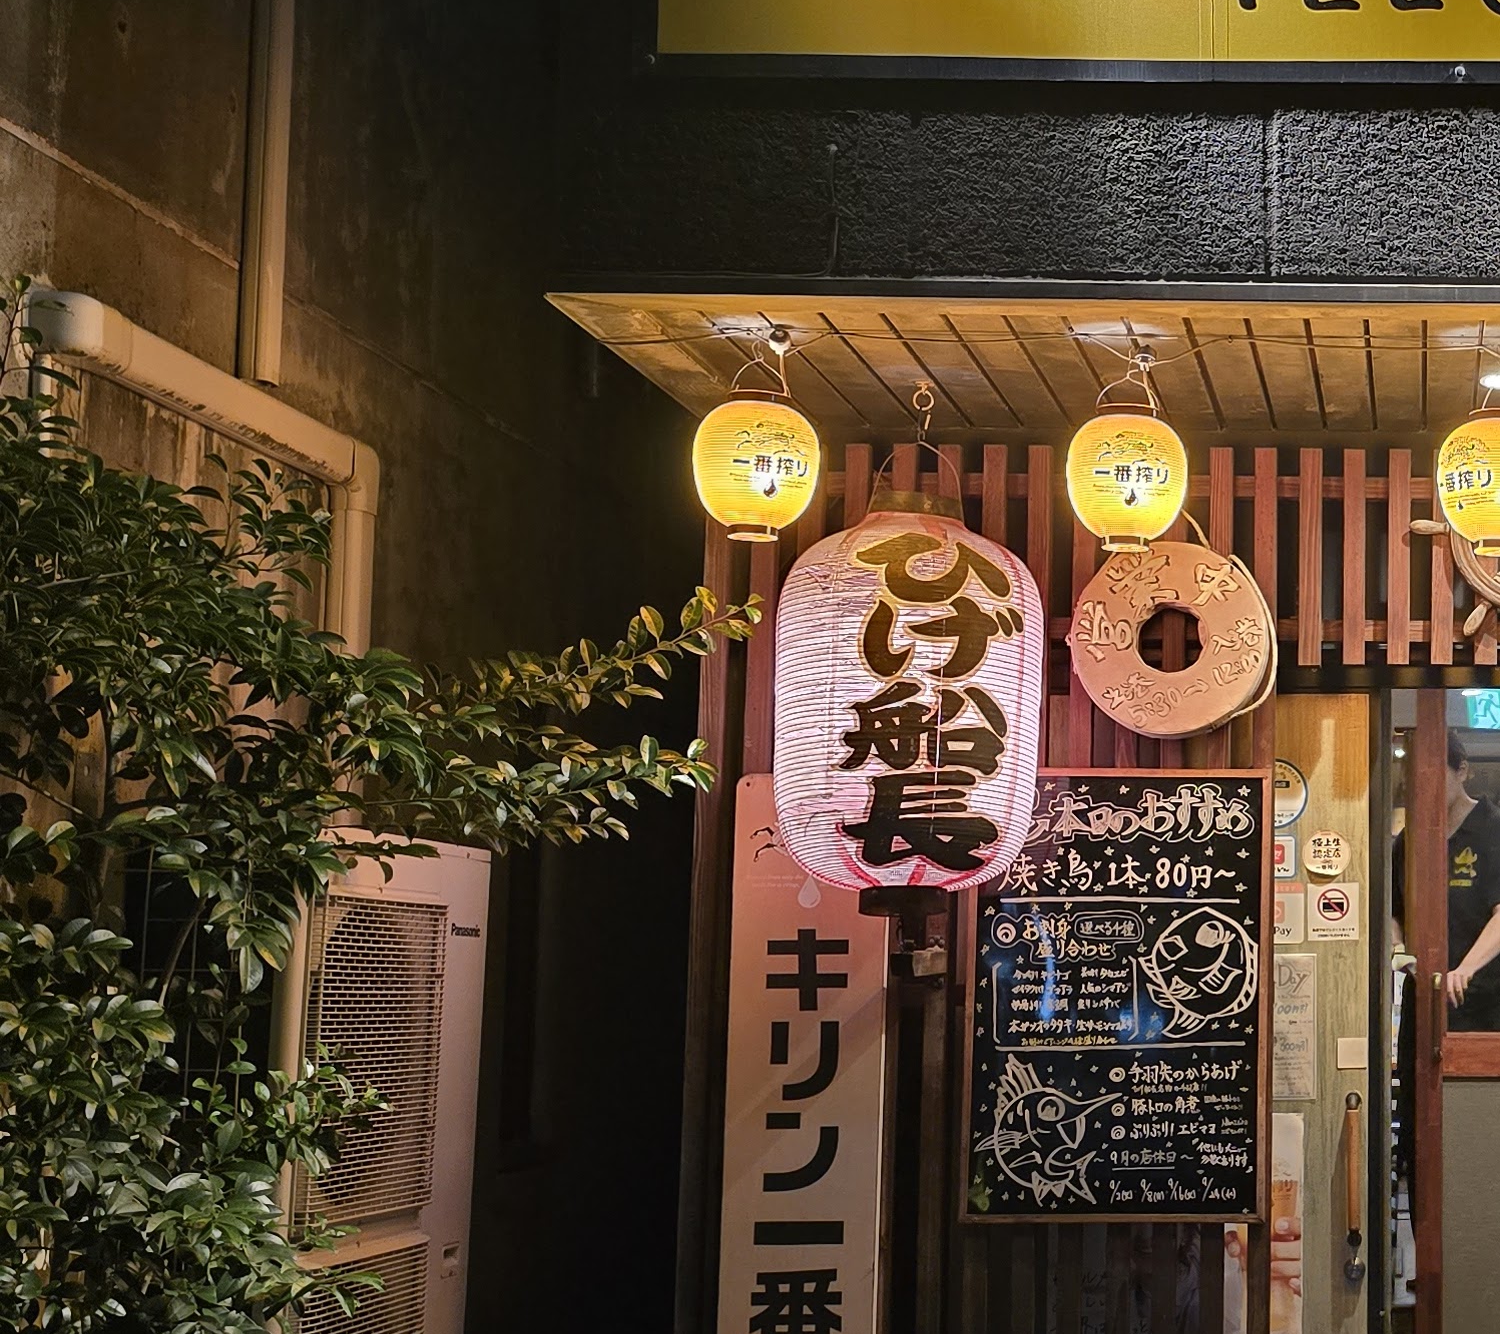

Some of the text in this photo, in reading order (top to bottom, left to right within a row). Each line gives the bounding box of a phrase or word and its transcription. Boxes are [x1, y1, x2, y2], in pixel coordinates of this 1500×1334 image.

[732, 454, 808, 478] 一番搾り
[1094, 464, 1169, 485] 一番搾り
[1440, 469, 1492, 493] 番搾り
[837, 531, 1025, 868] ひげ船長
[1312, 837, 1342, 847] 極上生
[450, 922, 482, 939] Panasonic
[1128, 1059, 1243, 1084] 手羽先のからあげ
[1131, 1095, 1201, 1115] 豚トロの角煮
